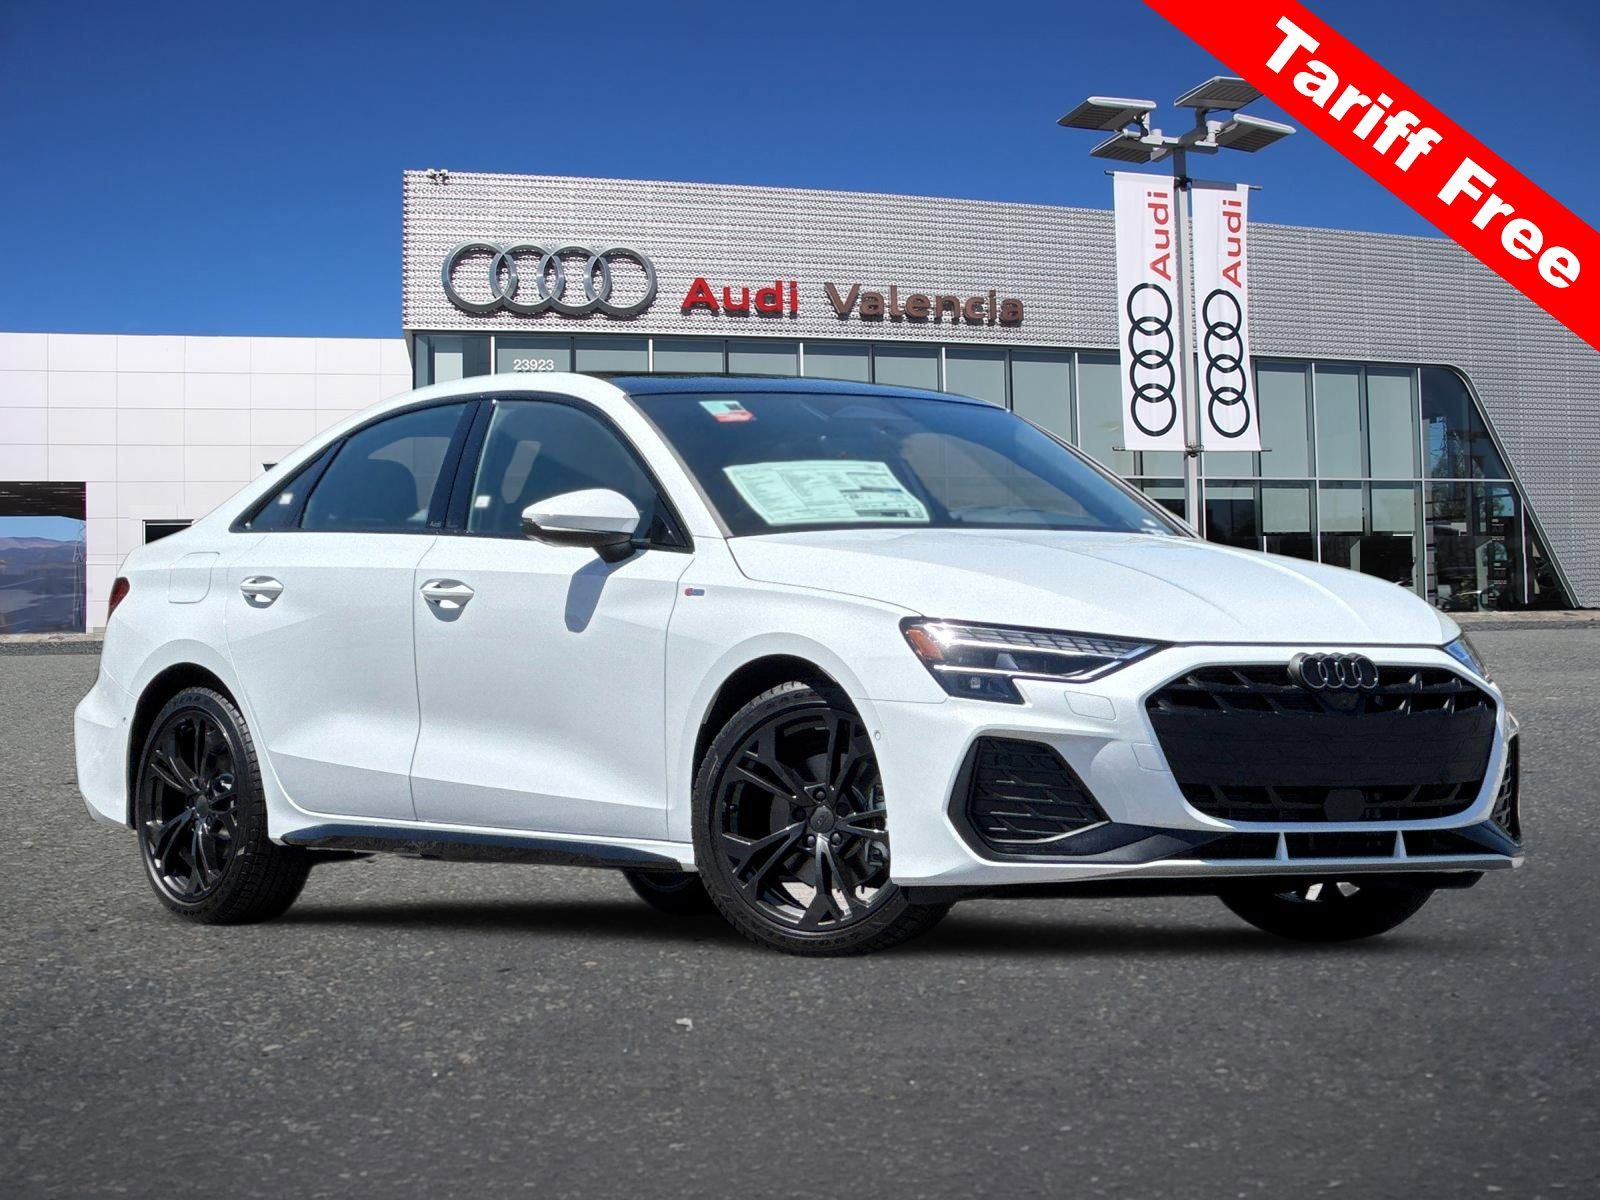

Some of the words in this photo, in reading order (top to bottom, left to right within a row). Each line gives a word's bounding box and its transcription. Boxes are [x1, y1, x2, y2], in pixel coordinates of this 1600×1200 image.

[1147, 191, 1172, 281] Audi
[1222, 199, 1242, 288] Audi
[681, 277, 799, 316] Audi
[824, 282, 1024, 324] Valencia
[513, 359, 554, 371] 23923
